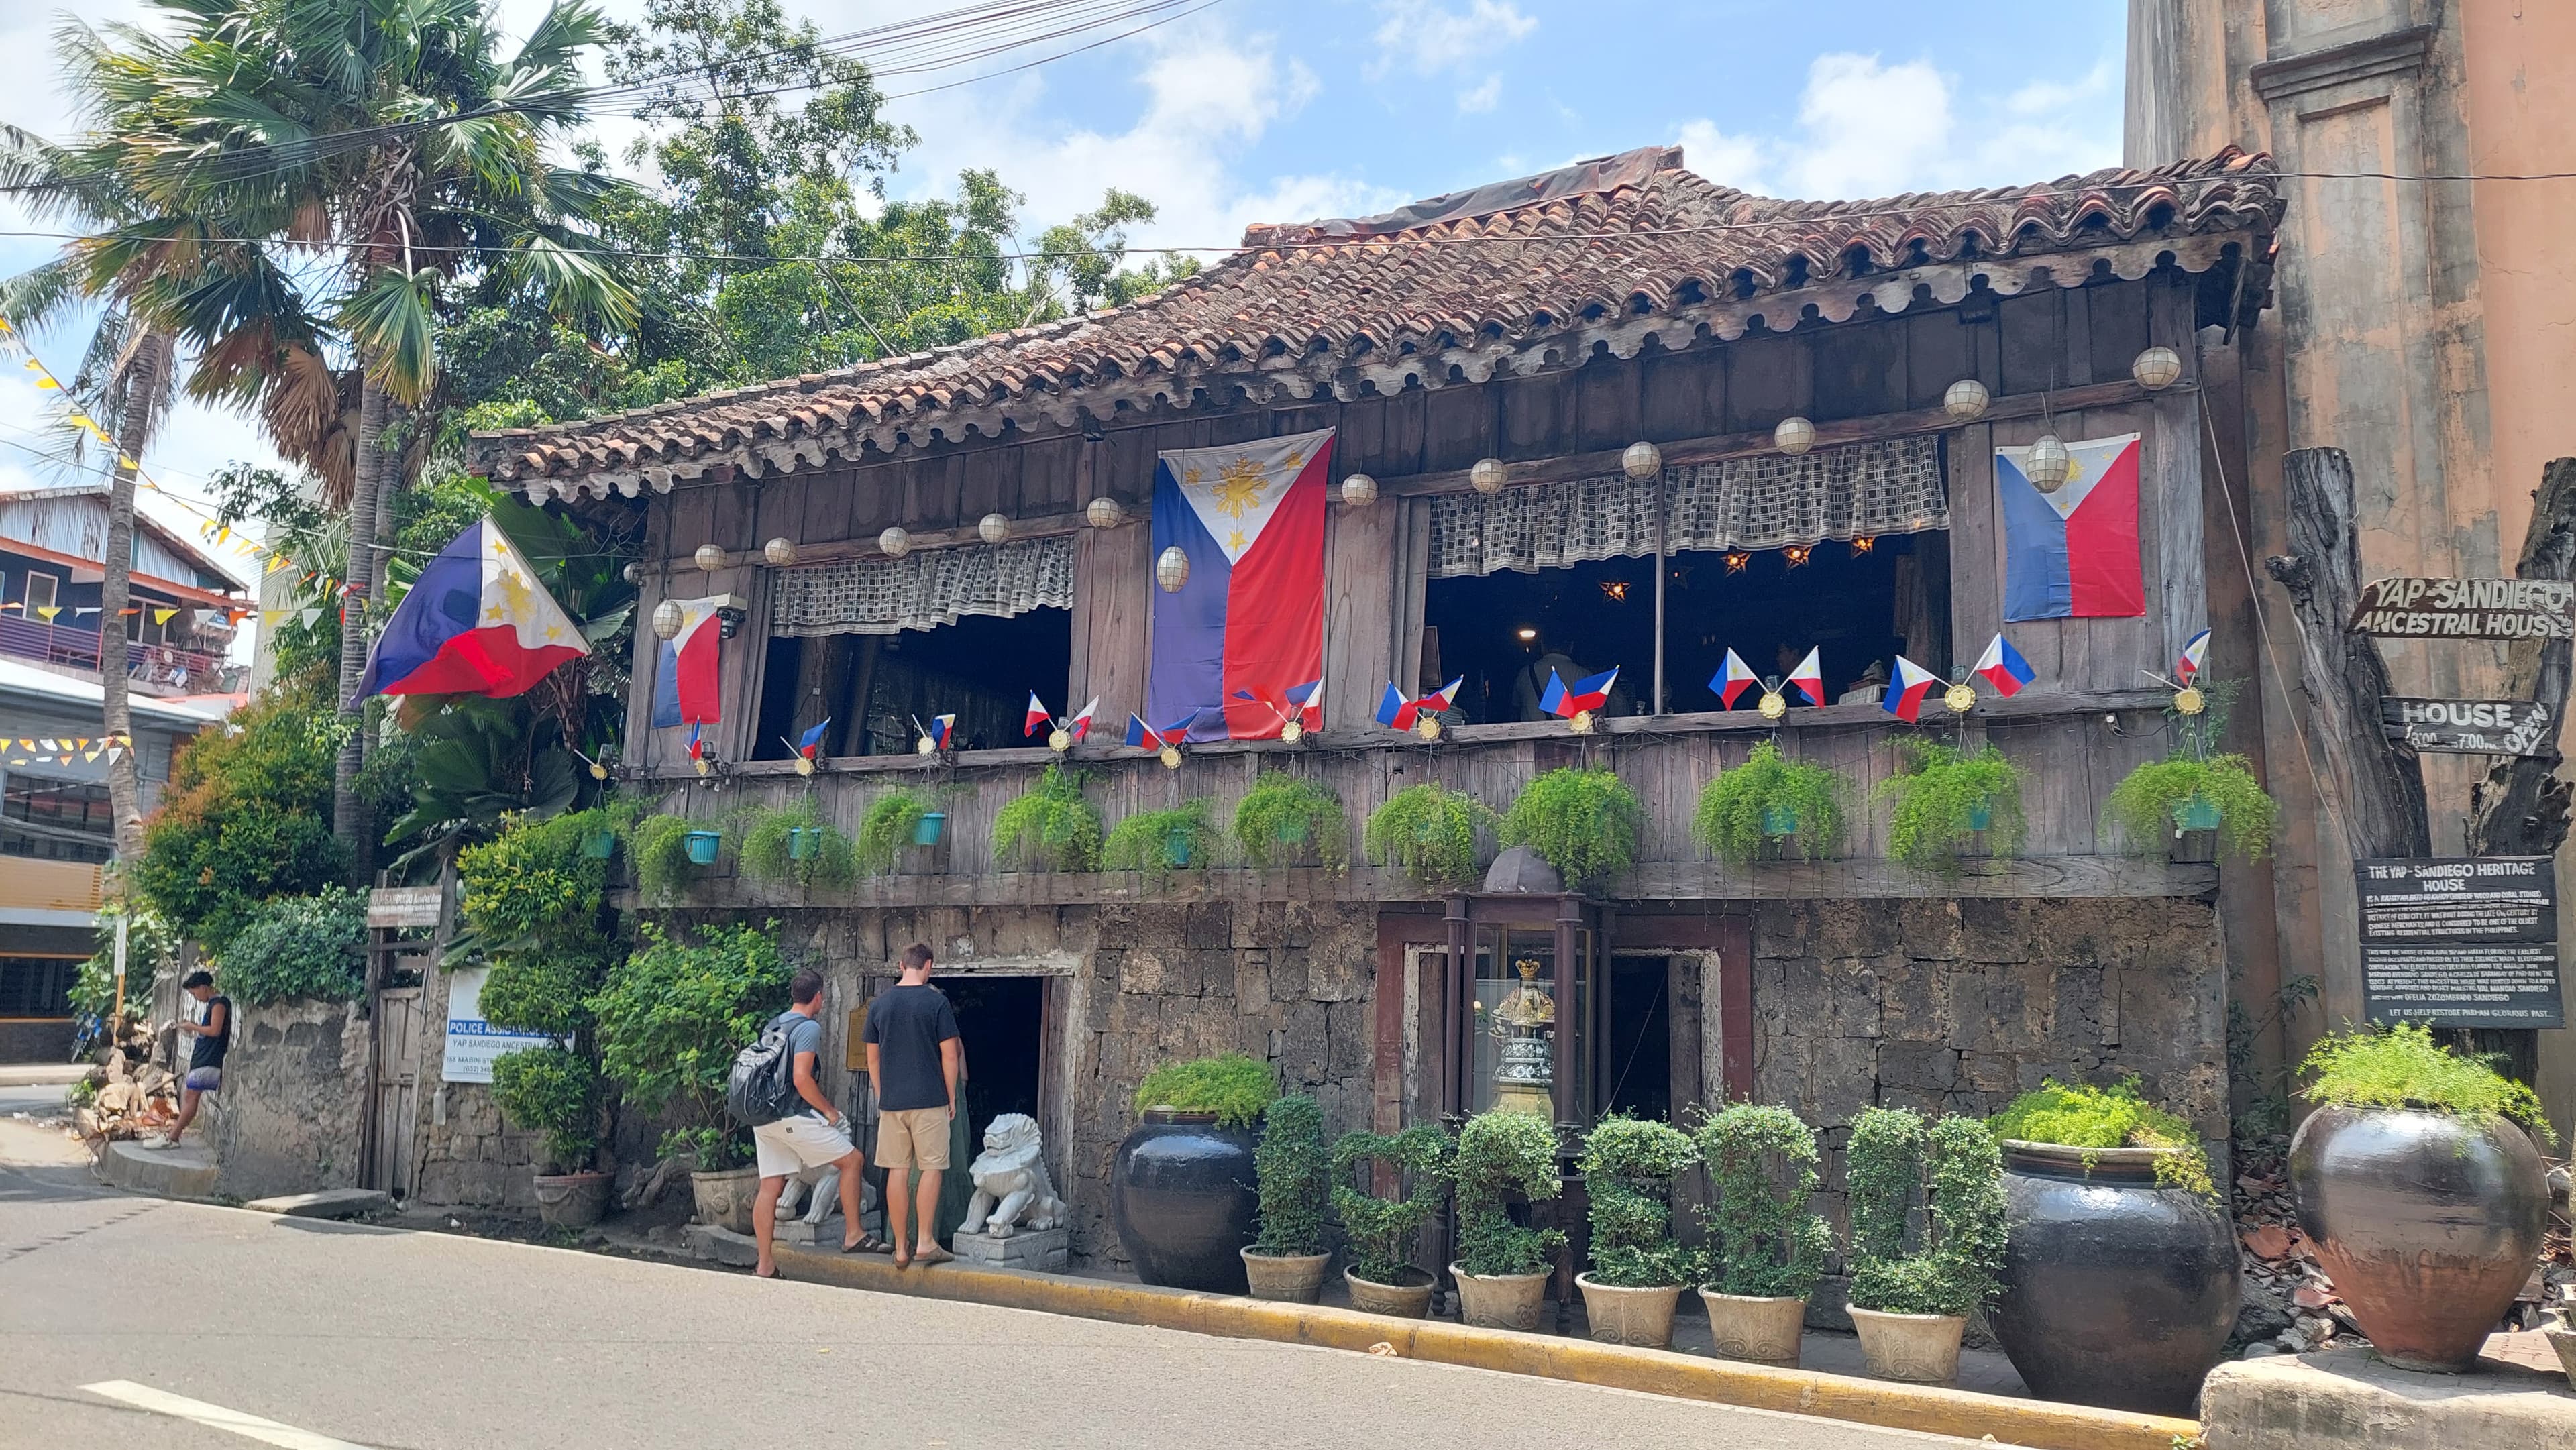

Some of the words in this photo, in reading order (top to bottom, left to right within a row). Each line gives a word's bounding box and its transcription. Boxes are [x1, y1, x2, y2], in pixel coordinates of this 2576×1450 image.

[2354, 611, 2481, 636] ANCESTRAL
[2485, 614, 2574, 638] HOUSE
[2402, 702, 2514, 728] HOUSE
[2503, 702, 2549, 754] OPEN
[2367, 866, 2388, 879] THE
[2477, 862, 2535, 876] HERITAGE
[2423, 879, 2466, 891] HOUSE
[450, 1022, 483, 1034] POLICE
[453, 1039, 467, 1047] YAP
[469, 1040, 500, 1048] SANDIEGO
[502, 1041, 541, 1050] ANCESTRAL
